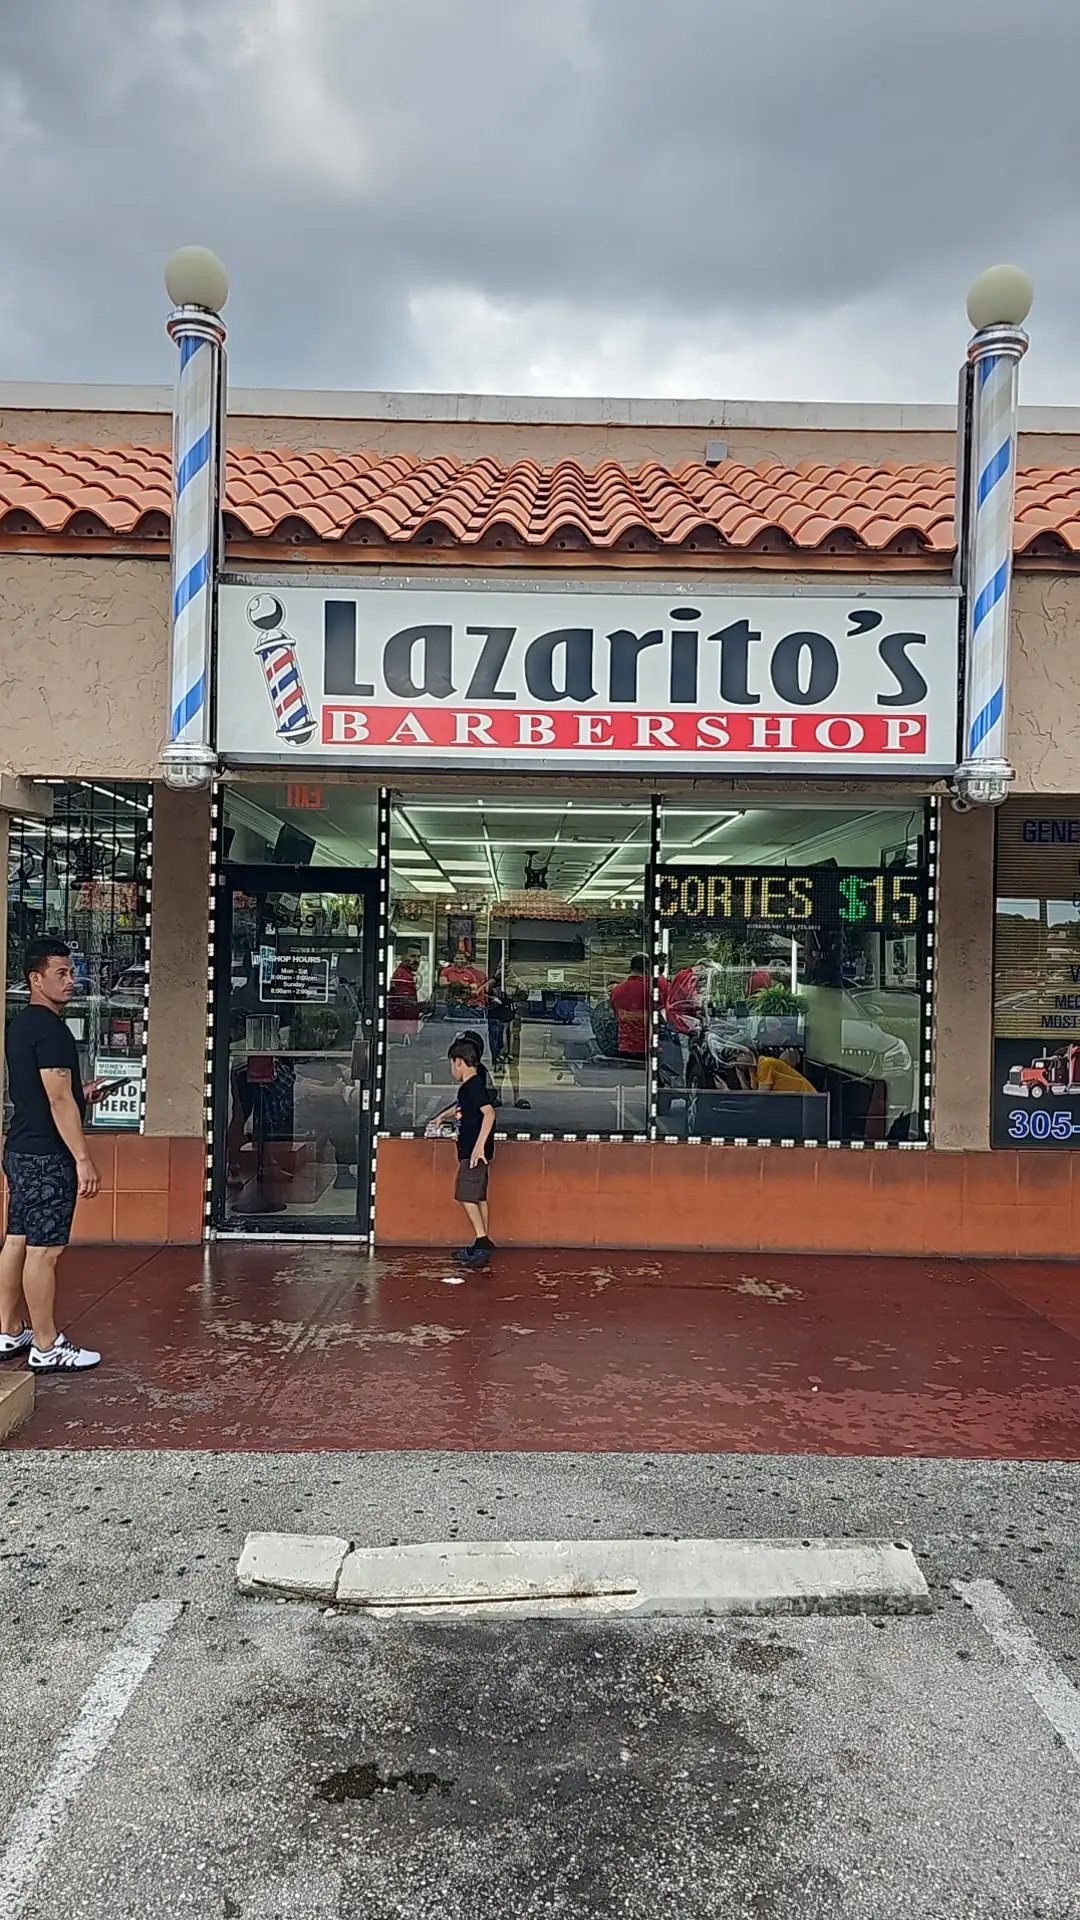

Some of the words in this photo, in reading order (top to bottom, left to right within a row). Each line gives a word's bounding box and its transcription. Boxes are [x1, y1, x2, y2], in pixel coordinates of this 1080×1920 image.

[323, 599, 928, 707] Lazarito's
[326, 709, 924, 751] BARBERSHOP
[660, 875, 813, 918] CORTES
[839, 875, 919, 924] $15
[1042, 1015, 1078, 1028] MOST
[100, 1101, 137, 1112] HERE
